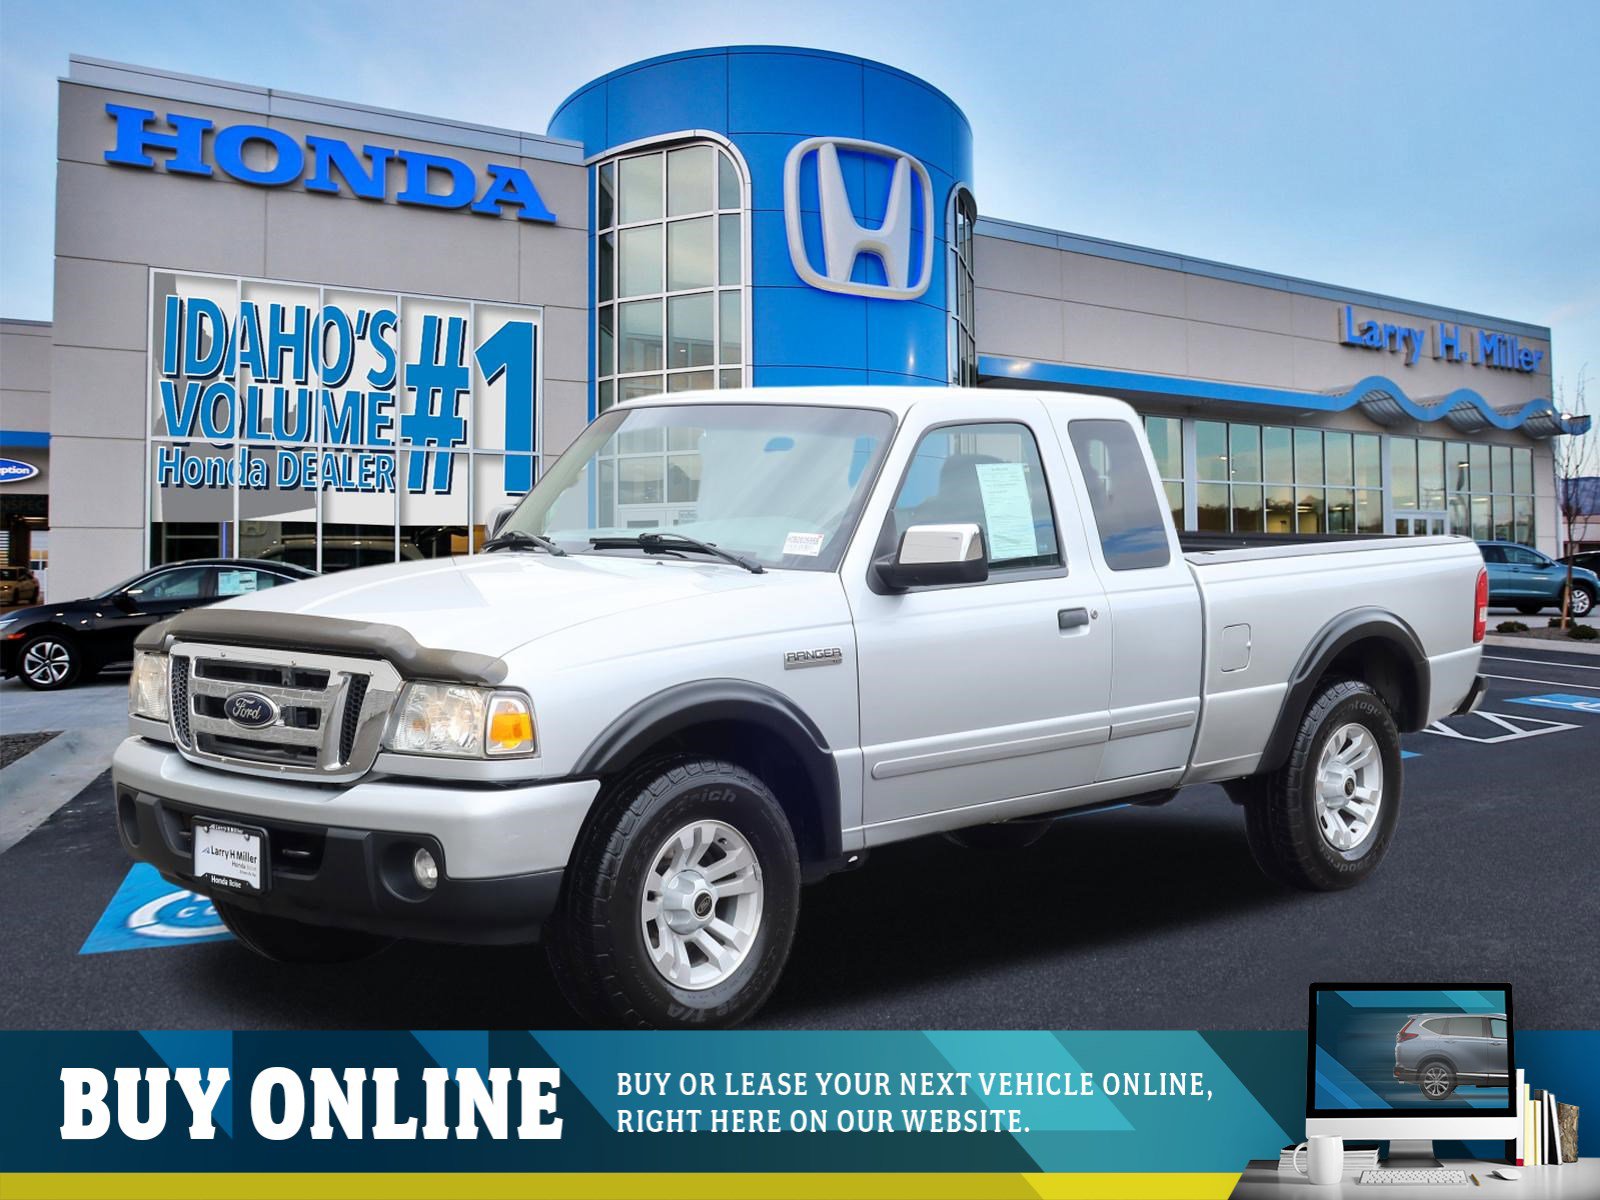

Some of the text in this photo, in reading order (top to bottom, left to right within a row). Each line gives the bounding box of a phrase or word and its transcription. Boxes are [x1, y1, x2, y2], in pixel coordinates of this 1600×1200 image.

[104, 103, 557, 223] HONDA
[163, 294, 401, 389] IDAHO'S
[1340, 304, 1544, 374] Larry H. Miller
[159, 379, 396, 448] VOLUME
[400, 314, 539, 496] #1
[0, 465, 30, 476] ption
[157, 446, 396, 494] Honda DEALER
[785, 647, 842, 662] RANGER
[232, 697, 262, 720] Ford
[211, 845, 257, 864] Larry H Miller
[211, 875, 228, 884] Honda
